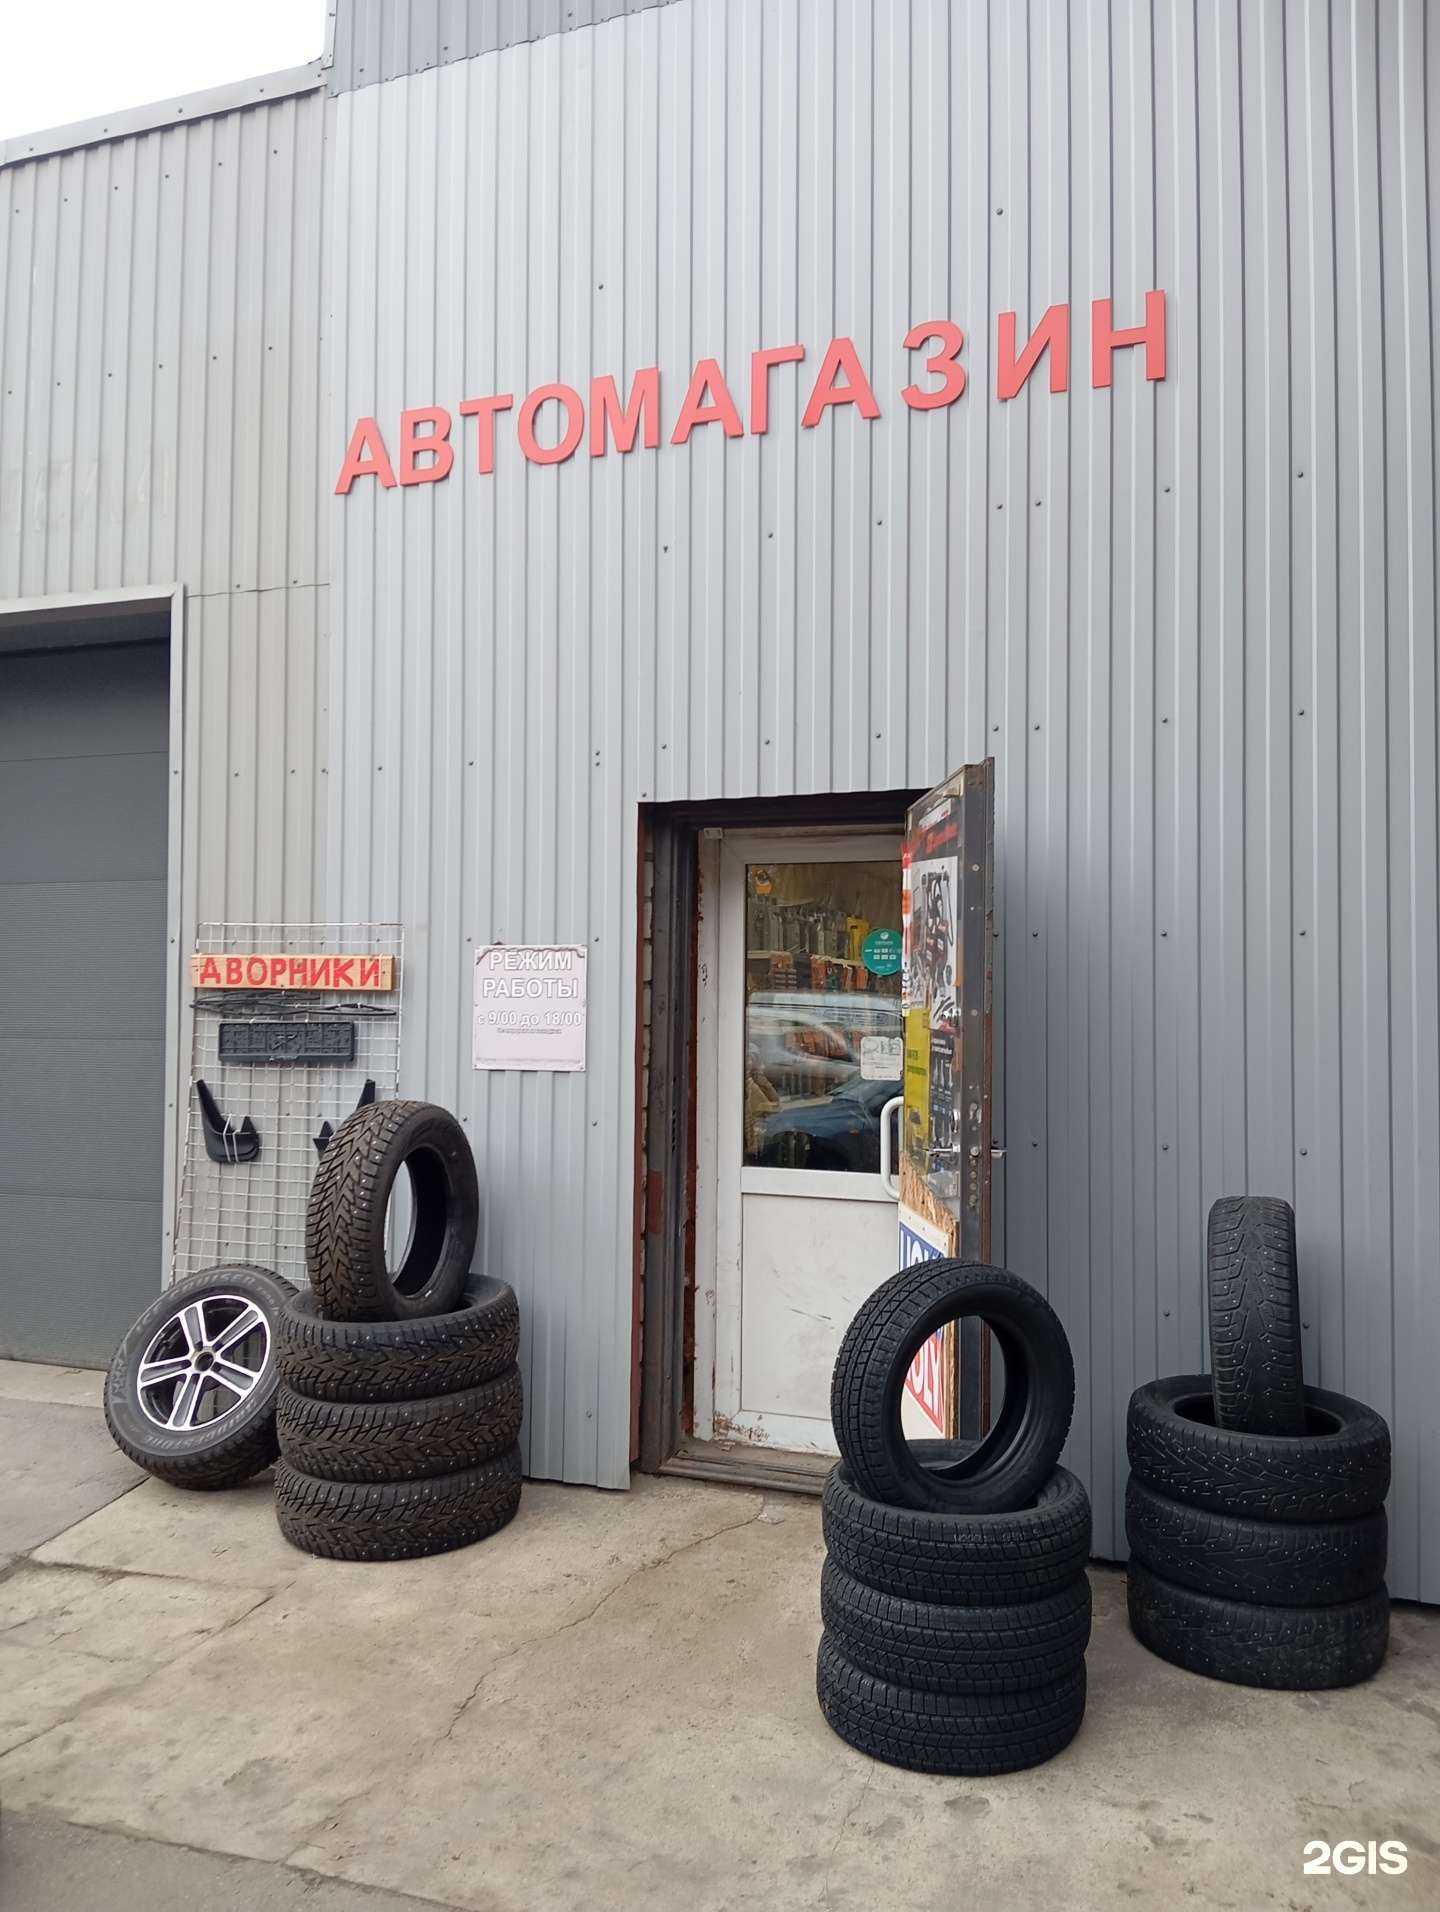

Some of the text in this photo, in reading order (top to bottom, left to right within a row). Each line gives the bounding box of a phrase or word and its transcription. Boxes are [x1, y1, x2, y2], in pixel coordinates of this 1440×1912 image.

[335, 289, 1166, 496] АВТОМАГАЗИН
[489, 951, 572, 971] РЕЖИМ
[200, 957, 380, 987] ДВОРНИКИ
[483, 978, 578, 998] РАБОТЫ
[488, 1010, 517, 1025] 9/00
[520, 1013, 540, 1027] до
[544, 1011, 582, 1026] 18/00
